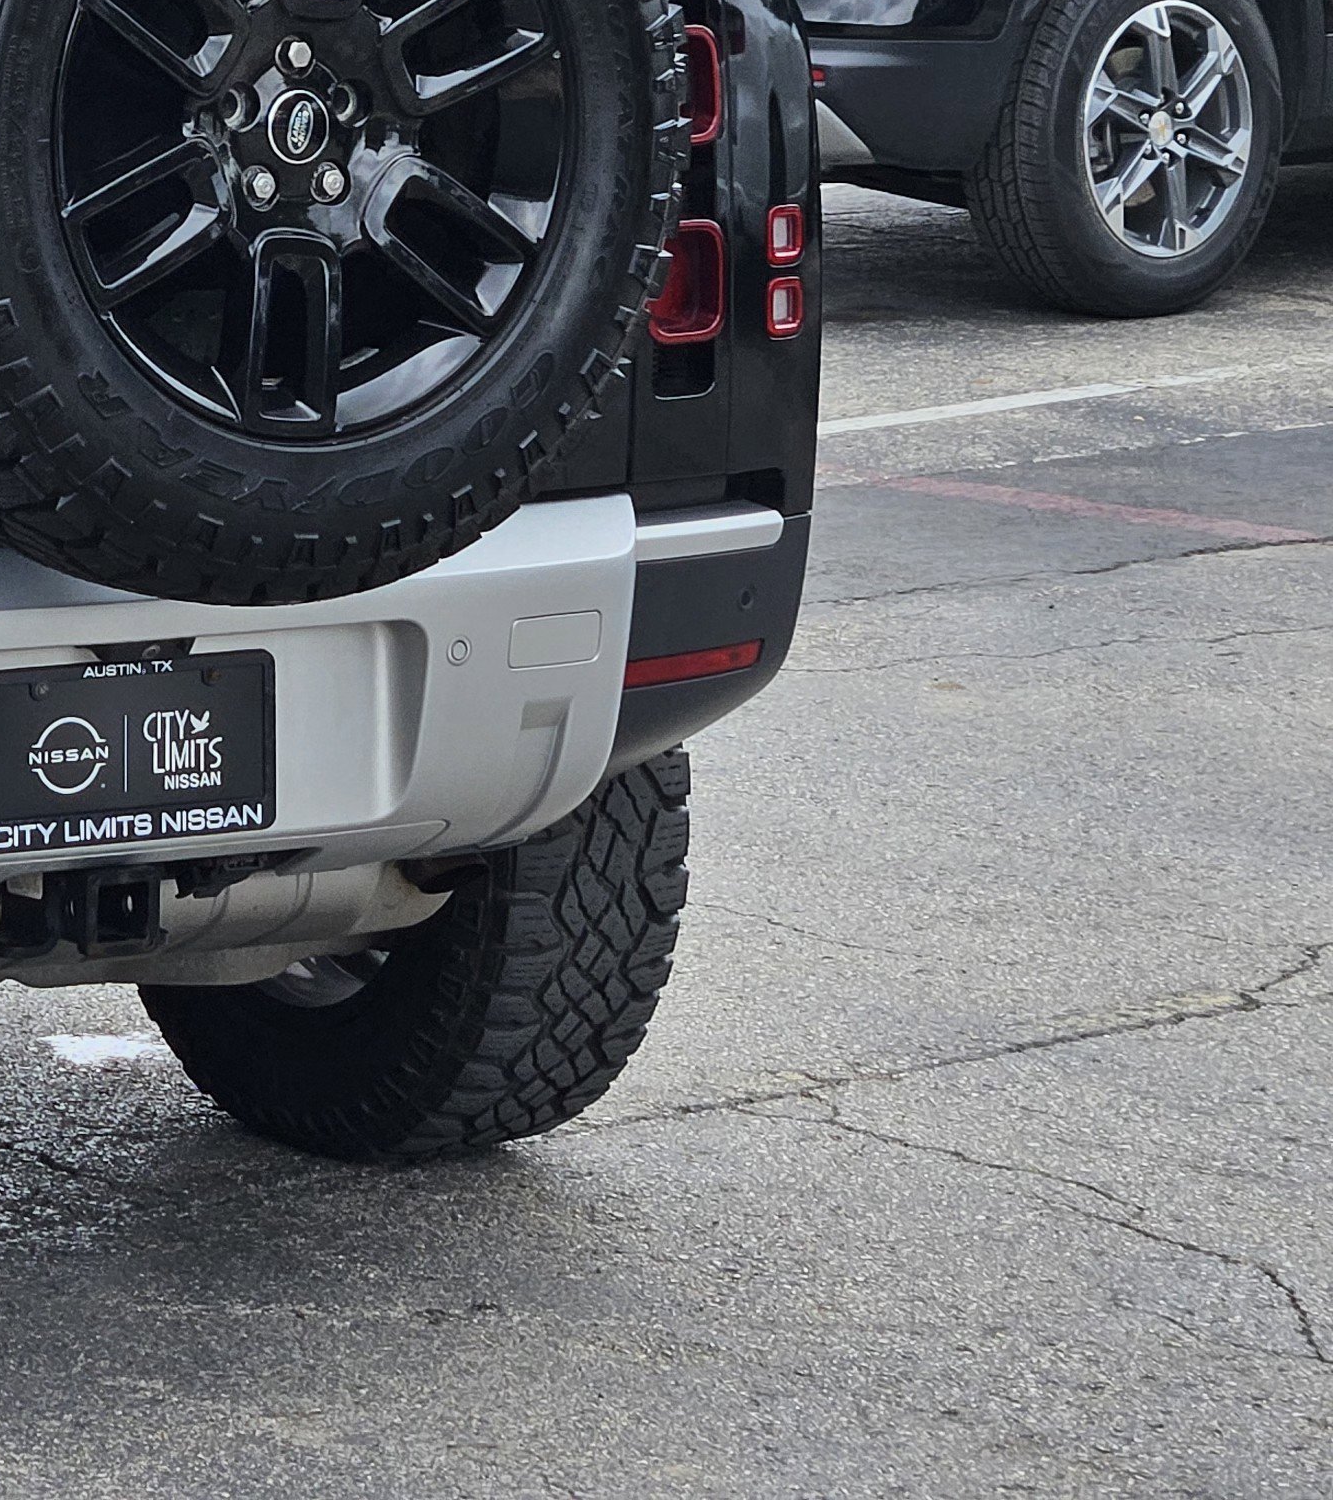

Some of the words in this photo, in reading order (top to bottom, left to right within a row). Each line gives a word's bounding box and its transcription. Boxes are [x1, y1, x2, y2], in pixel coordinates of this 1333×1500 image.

[83, 662, 147, 678] AUSTIN,
[151, 660, 173, 673] TX
[143, 708, 190, 742] CITY
[28, 745, 109, 766] NISSAN
[152, 736, 223, 774] LIMITS
[164, 771, 222, 791] NISSAN
[64, 813, 153, 843] LIMITS
[161, 803, 263, 835] NISSAN
